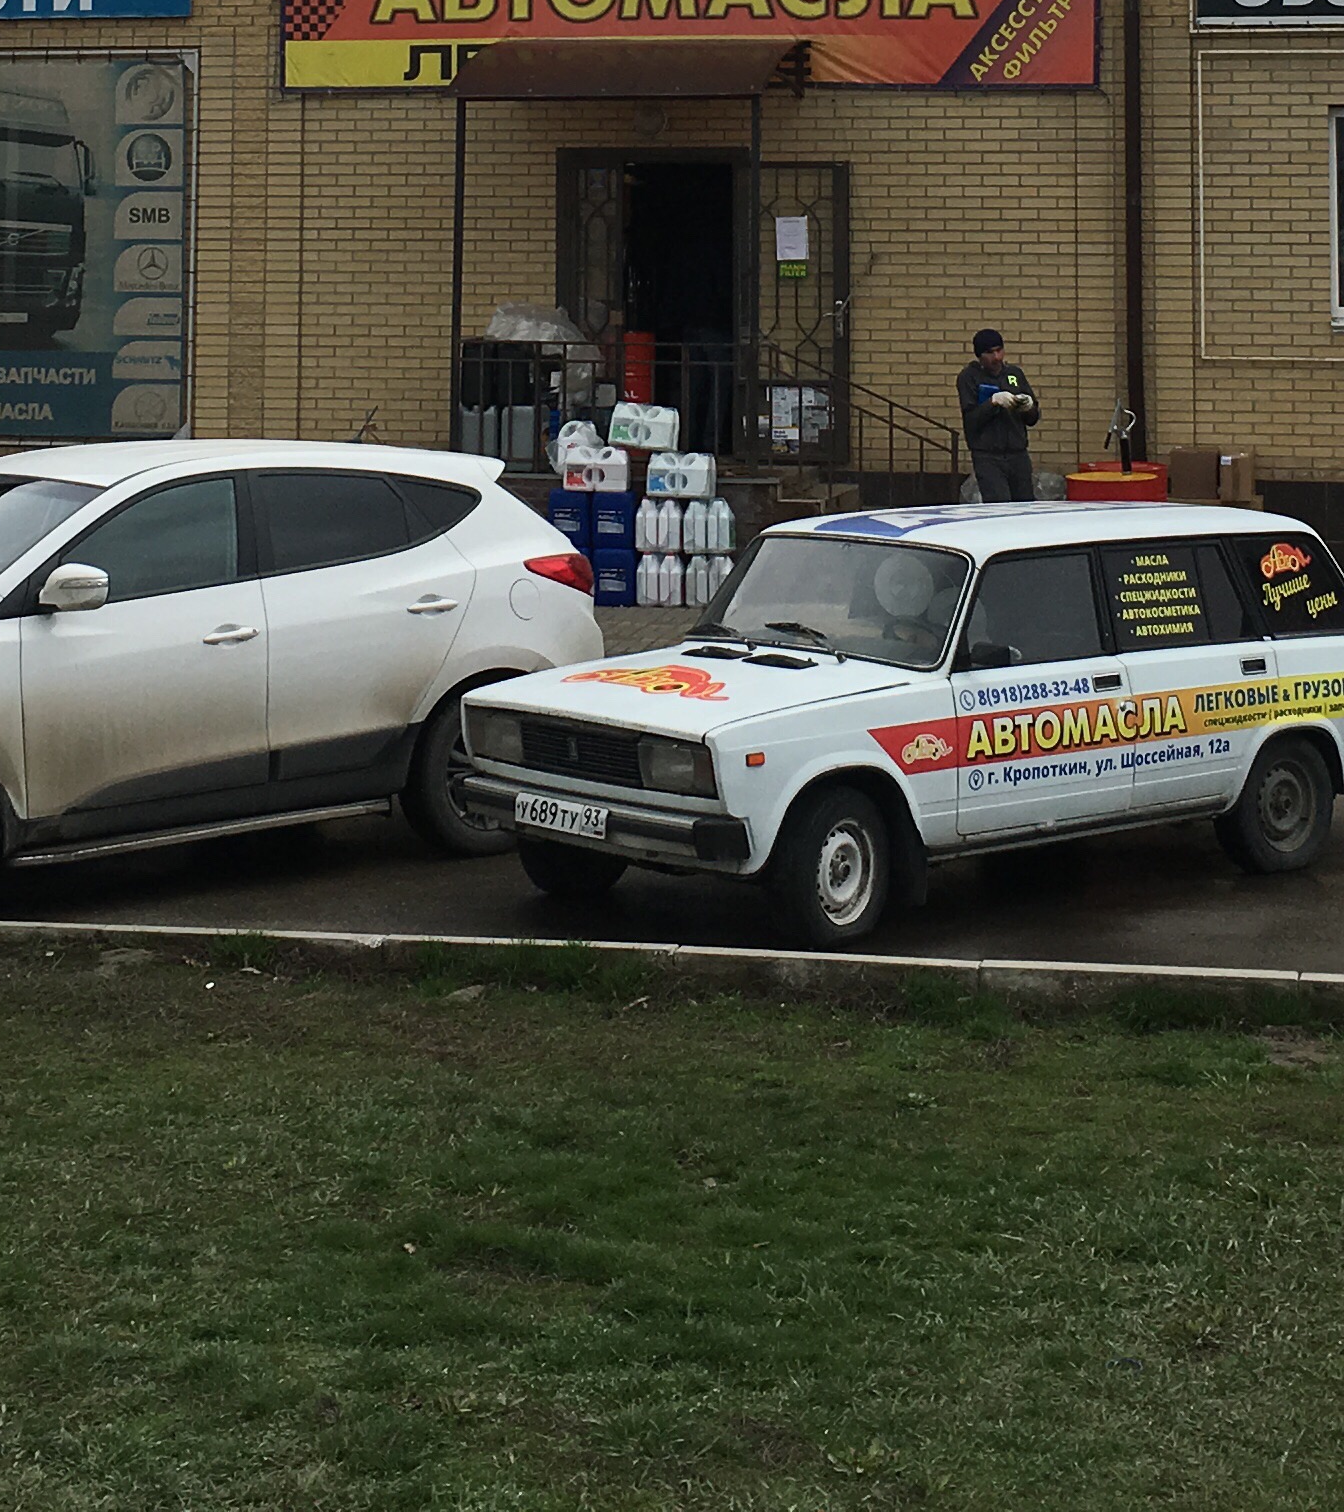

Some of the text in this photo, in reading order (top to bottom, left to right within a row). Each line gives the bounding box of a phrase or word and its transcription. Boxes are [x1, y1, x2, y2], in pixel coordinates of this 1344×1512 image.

[128, 207, 171, 224] SMB
[1135, 554, 1169, 567] МАСЛА
[1123, 570, 1187, 586] РАСХОДНИКИ
[1120, 587, 1197, 604] СПЕЦЖИДКОСТИ
[1262, 573, 1312, 612] Лучшие
[1306, 590, 1339, 619] цены
[1122, 606, 1201, 621] АВТОКОСМЕТИКА
[1135, 621, 1194, 637] АВТОХИМИЯ
[977, 676, 1091, 707] 8(918)288-32-48
[1194, 684, 1279, 714] ЛЕГКОВЫЕ
[966, 694, 1189, 762] АВТОМАСЛА
[1203, 711, 1267, 728] спецжидкости
[1273, 704, 1323, 720] расходники
[987, 771, 1000, 786] г.
[1003, 760, 1092, 784] Кропоткин,
[1095, 757, 1118, 773] ул.
[1120, 740, 1205, 769] Шоссейная,
[520, 799, 602, 829] У689ТУ 93
